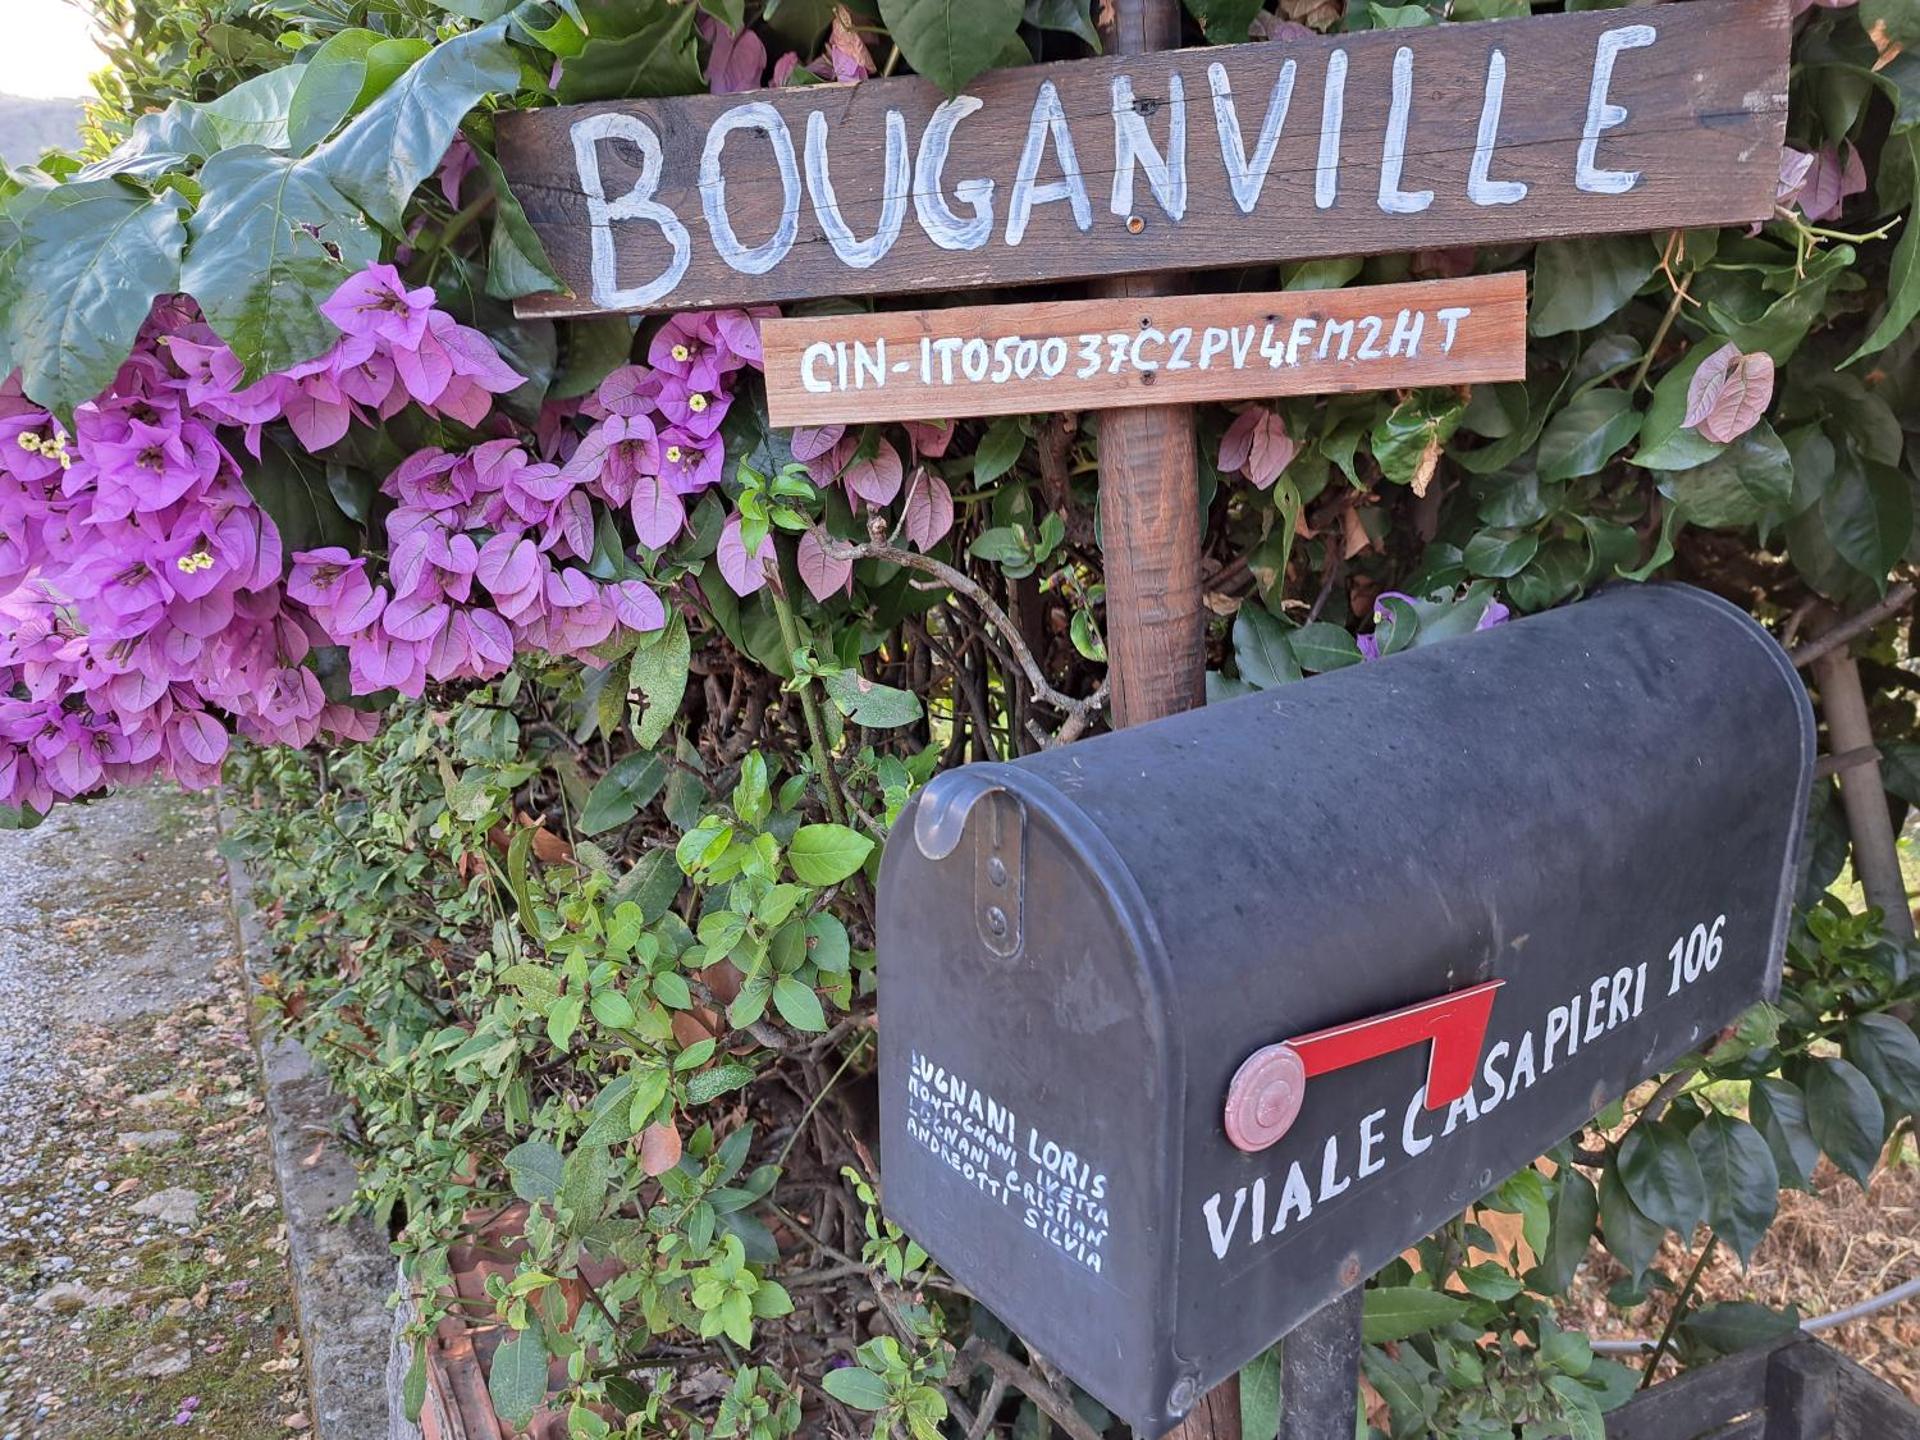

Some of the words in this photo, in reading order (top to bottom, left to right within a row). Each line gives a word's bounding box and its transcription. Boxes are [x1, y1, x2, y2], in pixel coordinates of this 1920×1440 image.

[569, 25, 1656, 309] BOUGANVILLE
[908, 1074, 1017, 1168] MONTAGNANI
[1036, 1169, 1109, 1227] IVETTA
[1028, 1128, 1107, 1199] LORIS
[1203, 1108, 1387, 1260] VIALE
[1402, 962, 1647, 1158] CASAPIERI
[1668, 915, 1726, 997] 106
[907, 1117, 1009, 1205] ANDREOTTI
[1023, 1208, 1101, 1273] SILVIA
